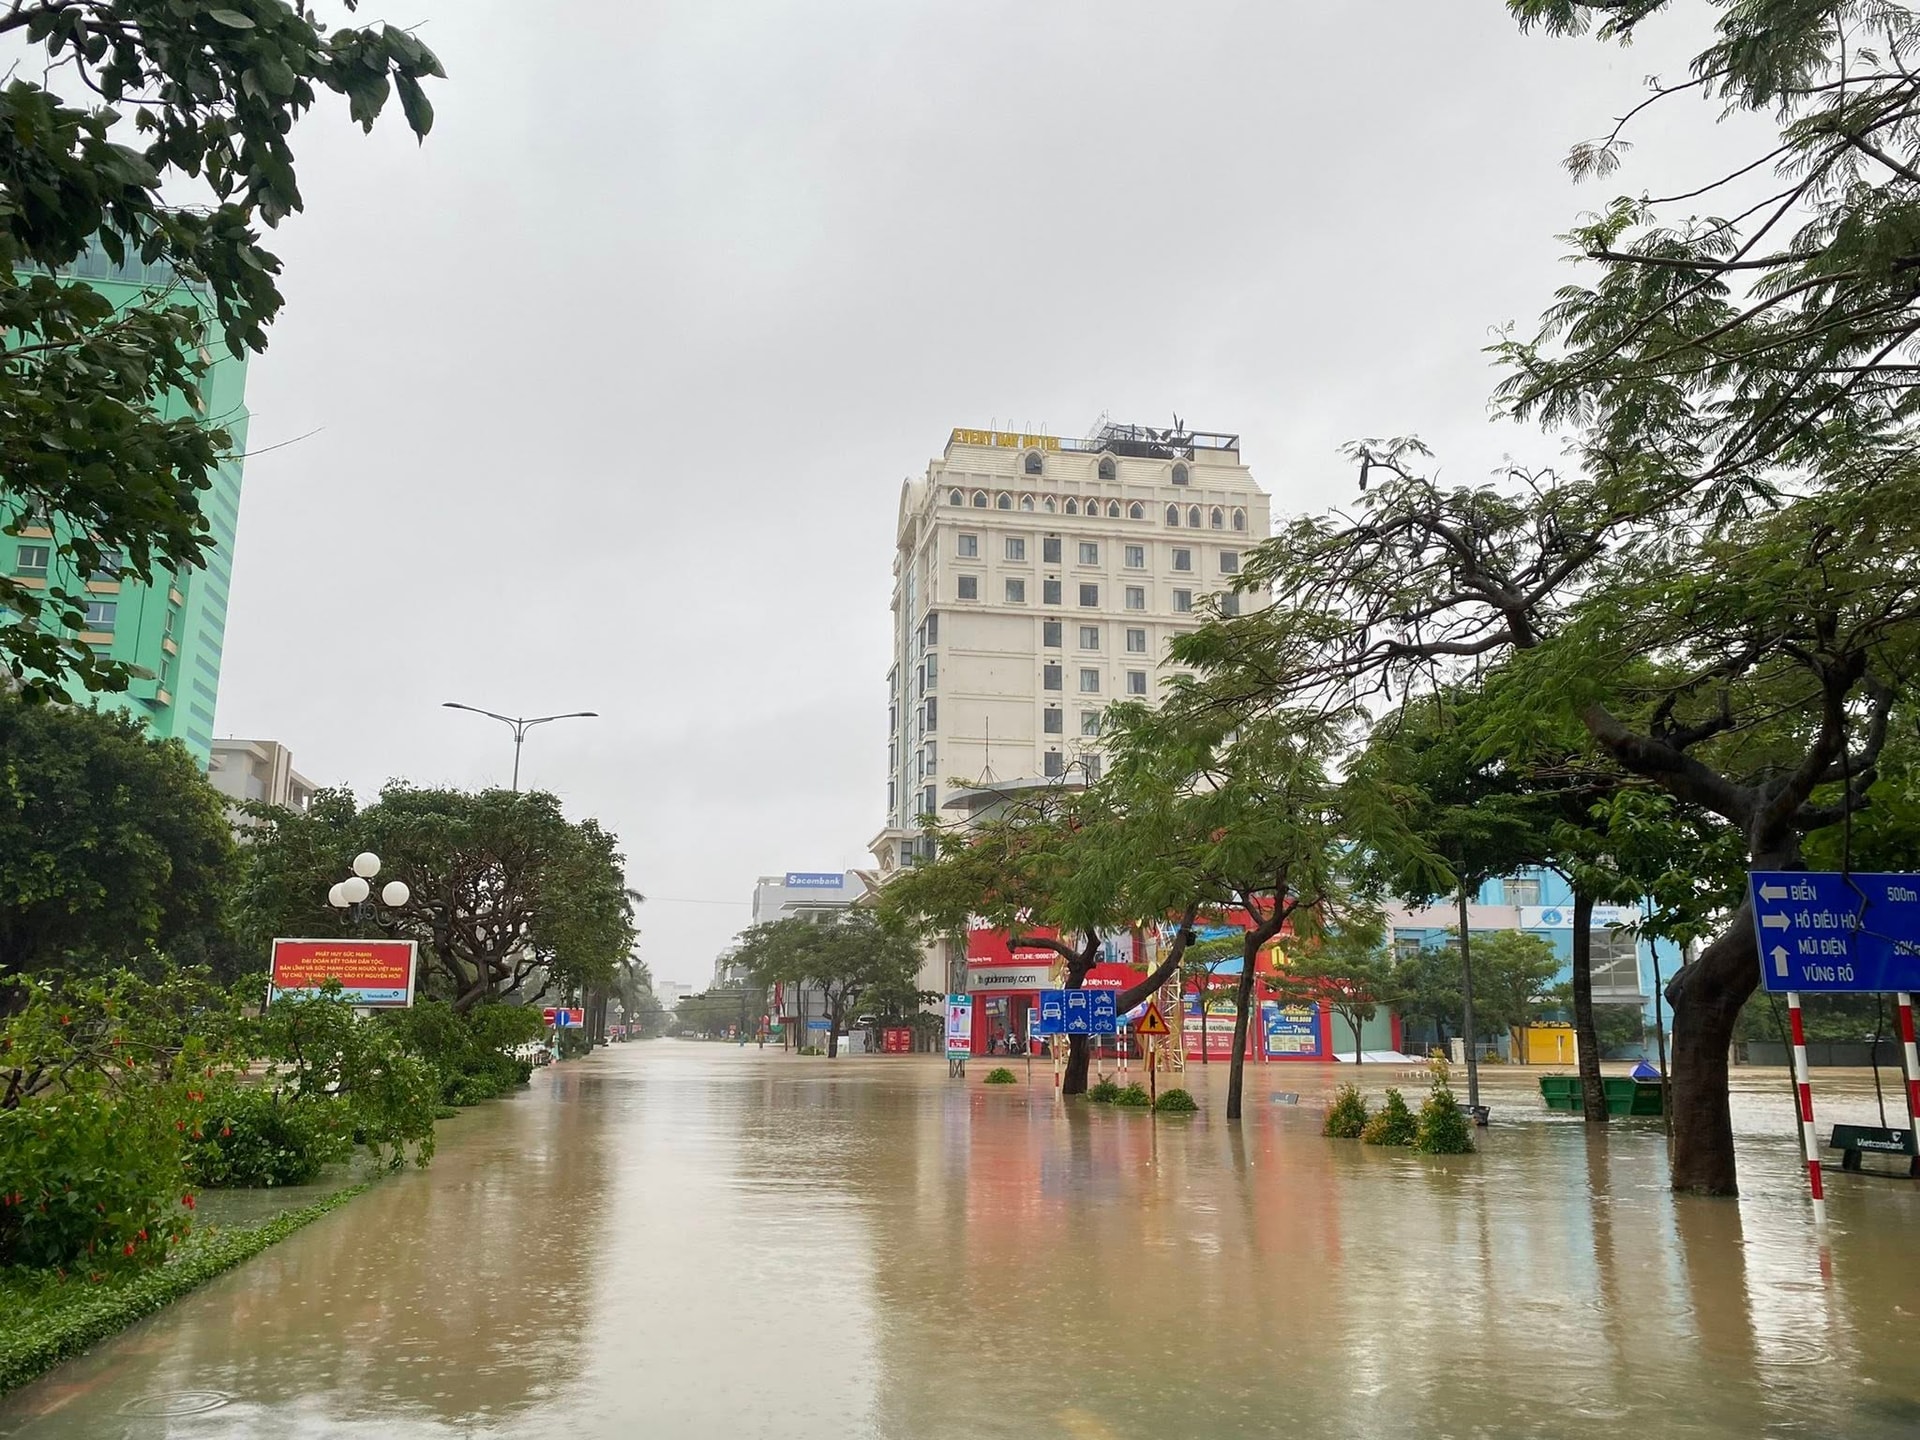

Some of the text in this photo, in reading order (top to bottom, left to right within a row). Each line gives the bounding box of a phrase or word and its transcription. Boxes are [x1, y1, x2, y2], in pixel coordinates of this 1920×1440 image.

[788, 875, 841, 885] Sacombank
[1790, 878, 1817, 901] BIỂN
[1887, 886, 1918, 902] 500m
[1798, 936, 1847, 958] MŨI ĐIỆN
[1802, 963, 1855, 982] VŨNG RÔ
[1856, 1137, 1905, 1150] Vietcombank
